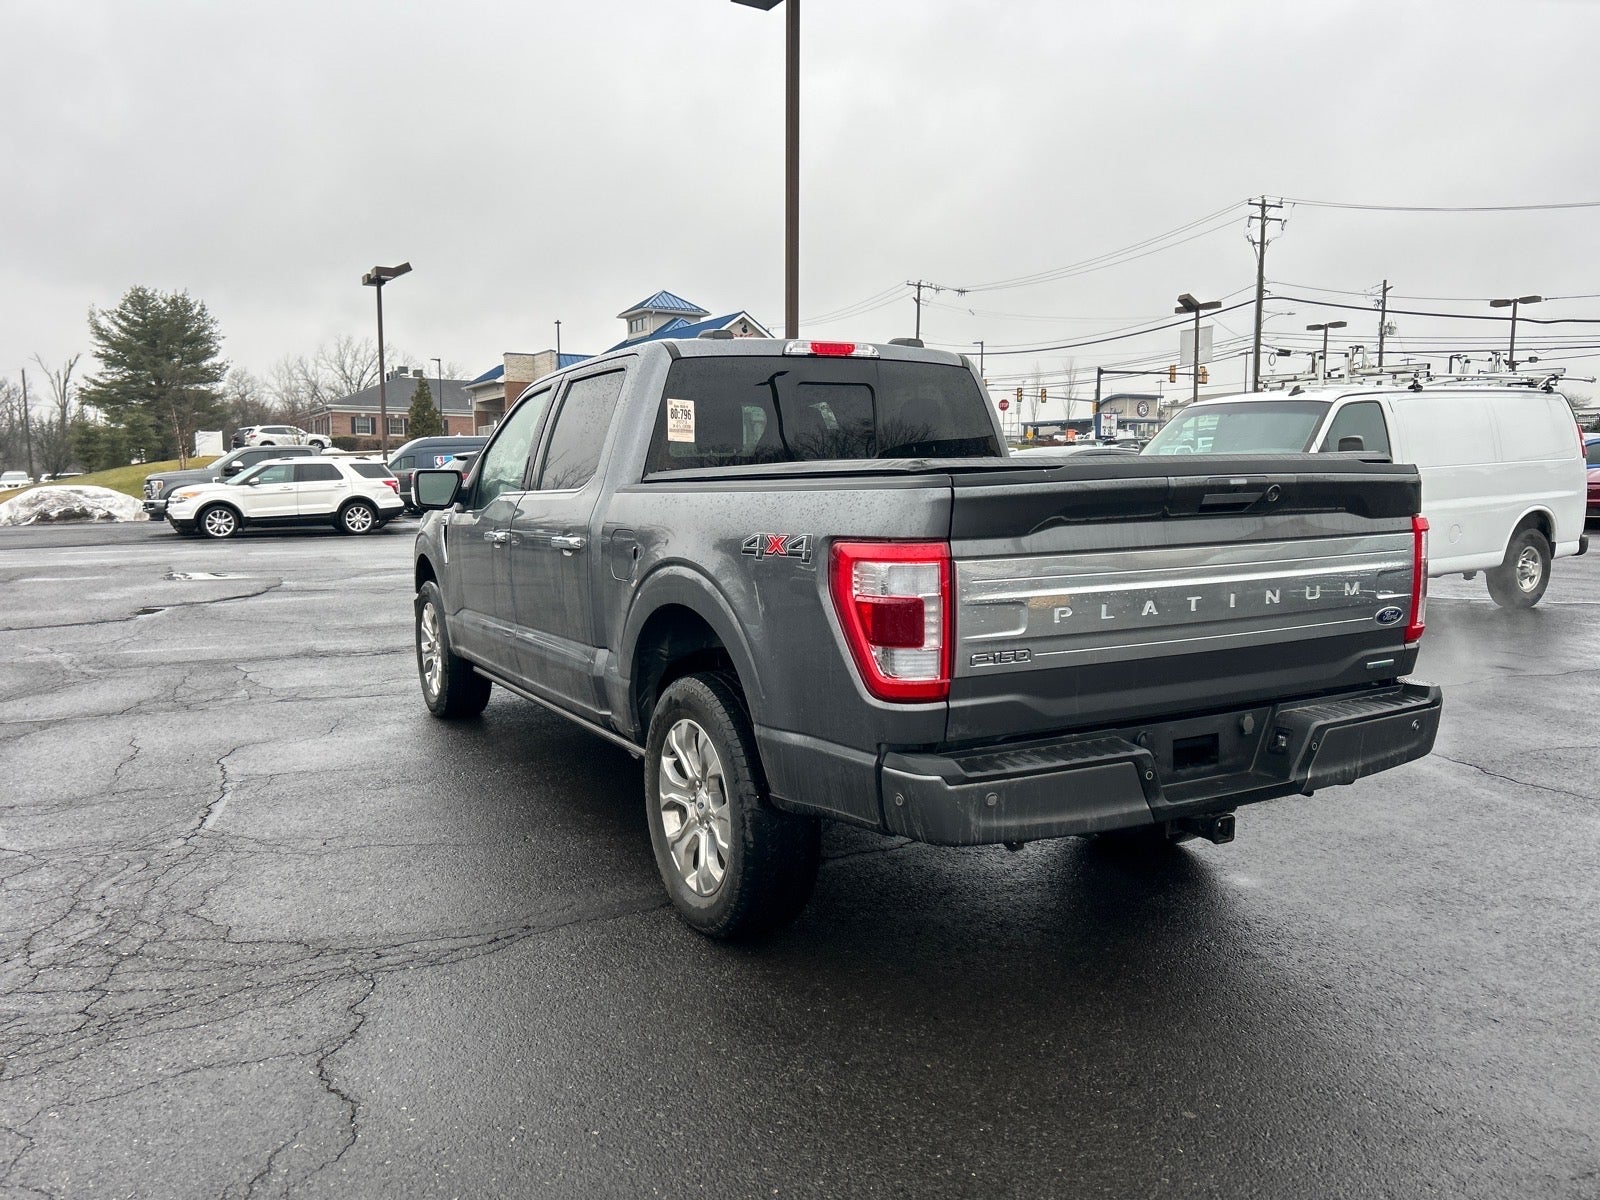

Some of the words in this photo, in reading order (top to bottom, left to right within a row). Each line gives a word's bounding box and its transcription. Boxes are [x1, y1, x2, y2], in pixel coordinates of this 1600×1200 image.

[1053, 581, 1360, 623] PLATINUM
[1382, 610, 1399, 621] Ford
[970, 648, 1032, 668] F-150
